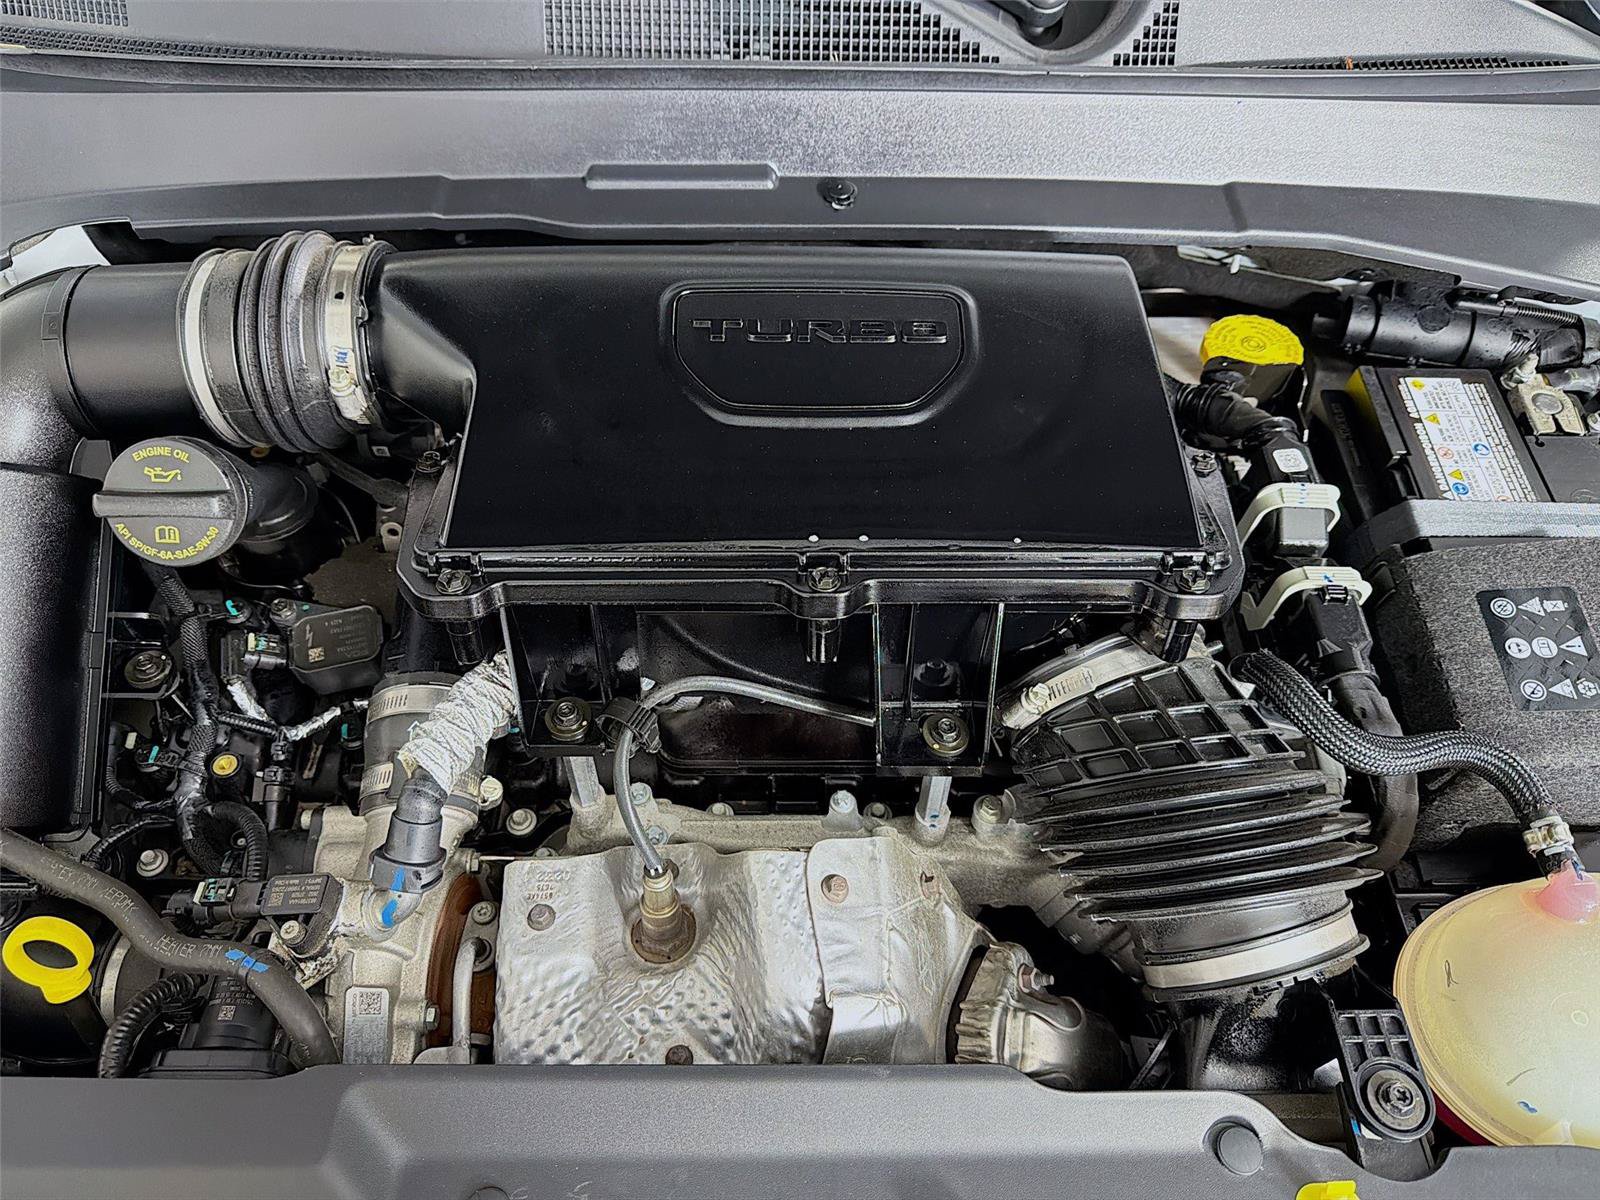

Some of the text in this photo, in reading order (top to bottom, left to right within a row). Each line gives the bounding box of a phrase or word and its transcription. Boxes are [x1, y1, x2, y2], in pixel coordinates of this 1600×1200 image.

[692, 318, 948, 344] TURBO
[132, 446, 192, 463] ENGINE OIL
[115, 522, 129, 540] API
